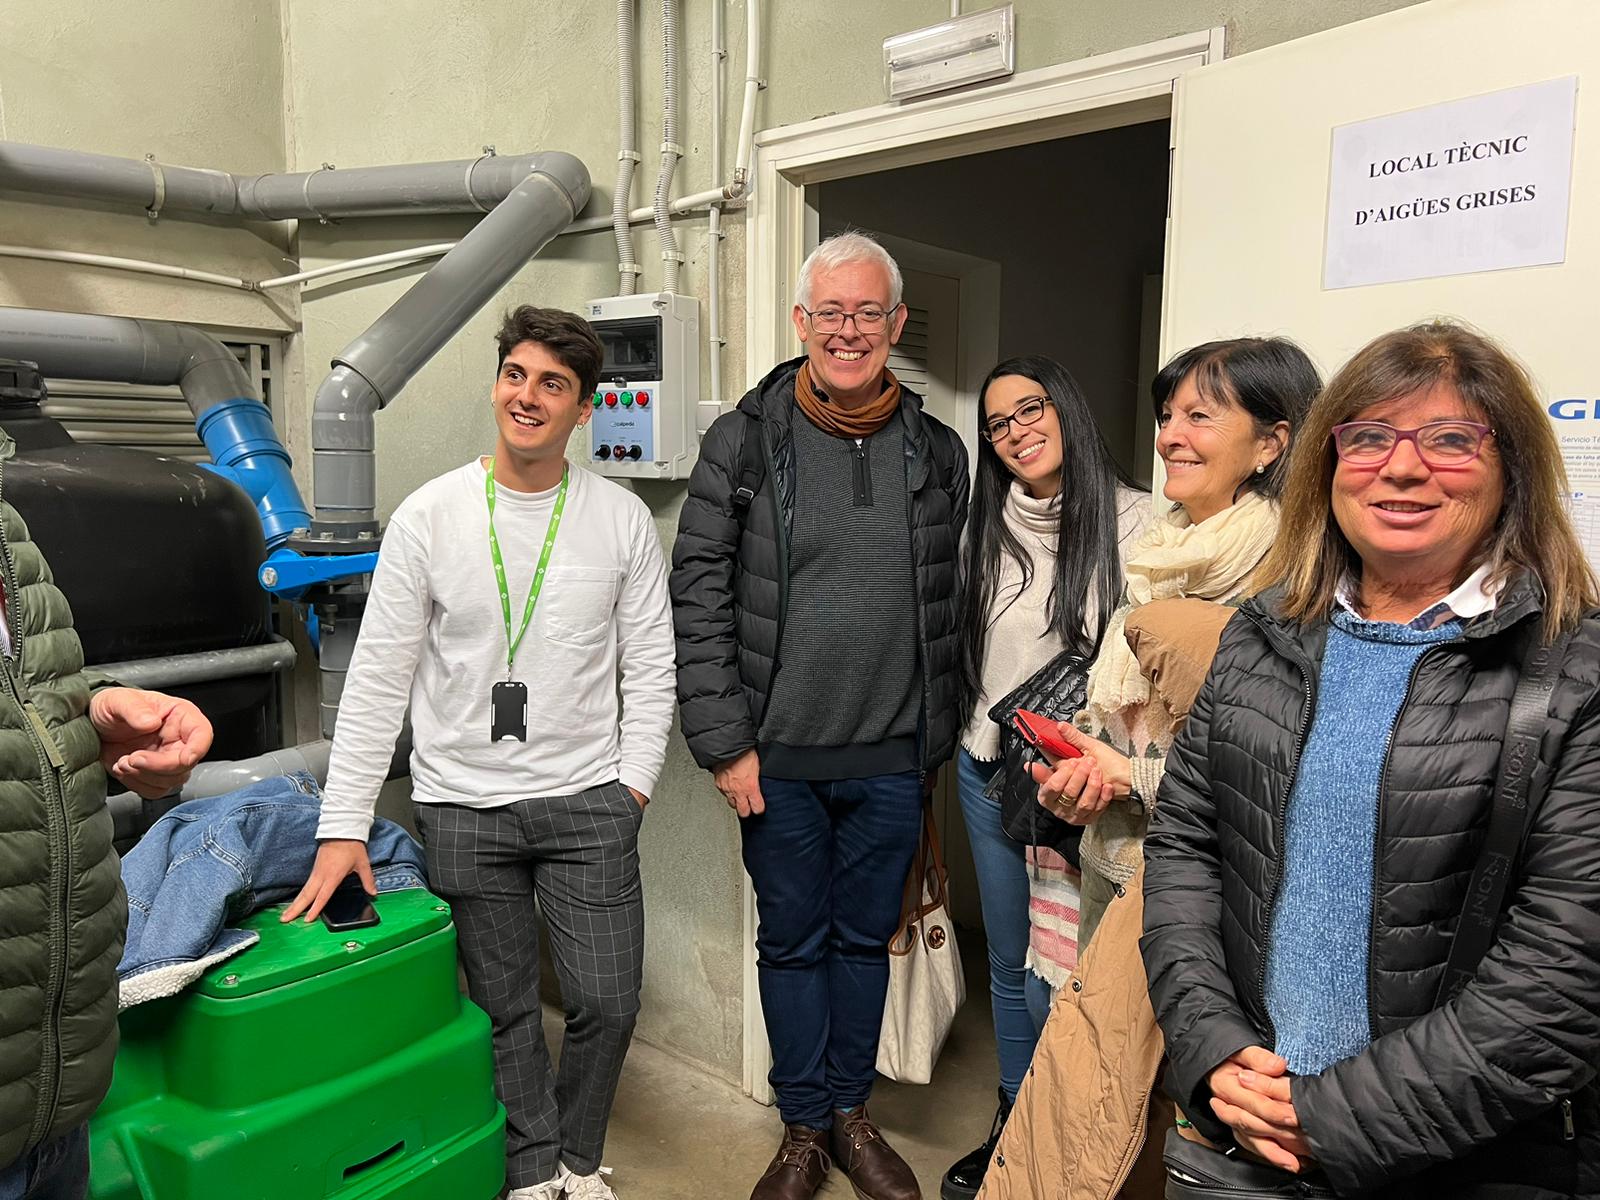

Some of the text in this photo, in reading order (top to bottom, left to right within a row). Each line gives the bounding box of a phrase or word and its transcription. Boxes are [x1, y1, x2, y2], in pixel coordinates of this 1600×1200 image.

[1369, 134, 1528, 179] LOCAL TÈCNIC
[1456, 184, 1536, 211] GRISES
